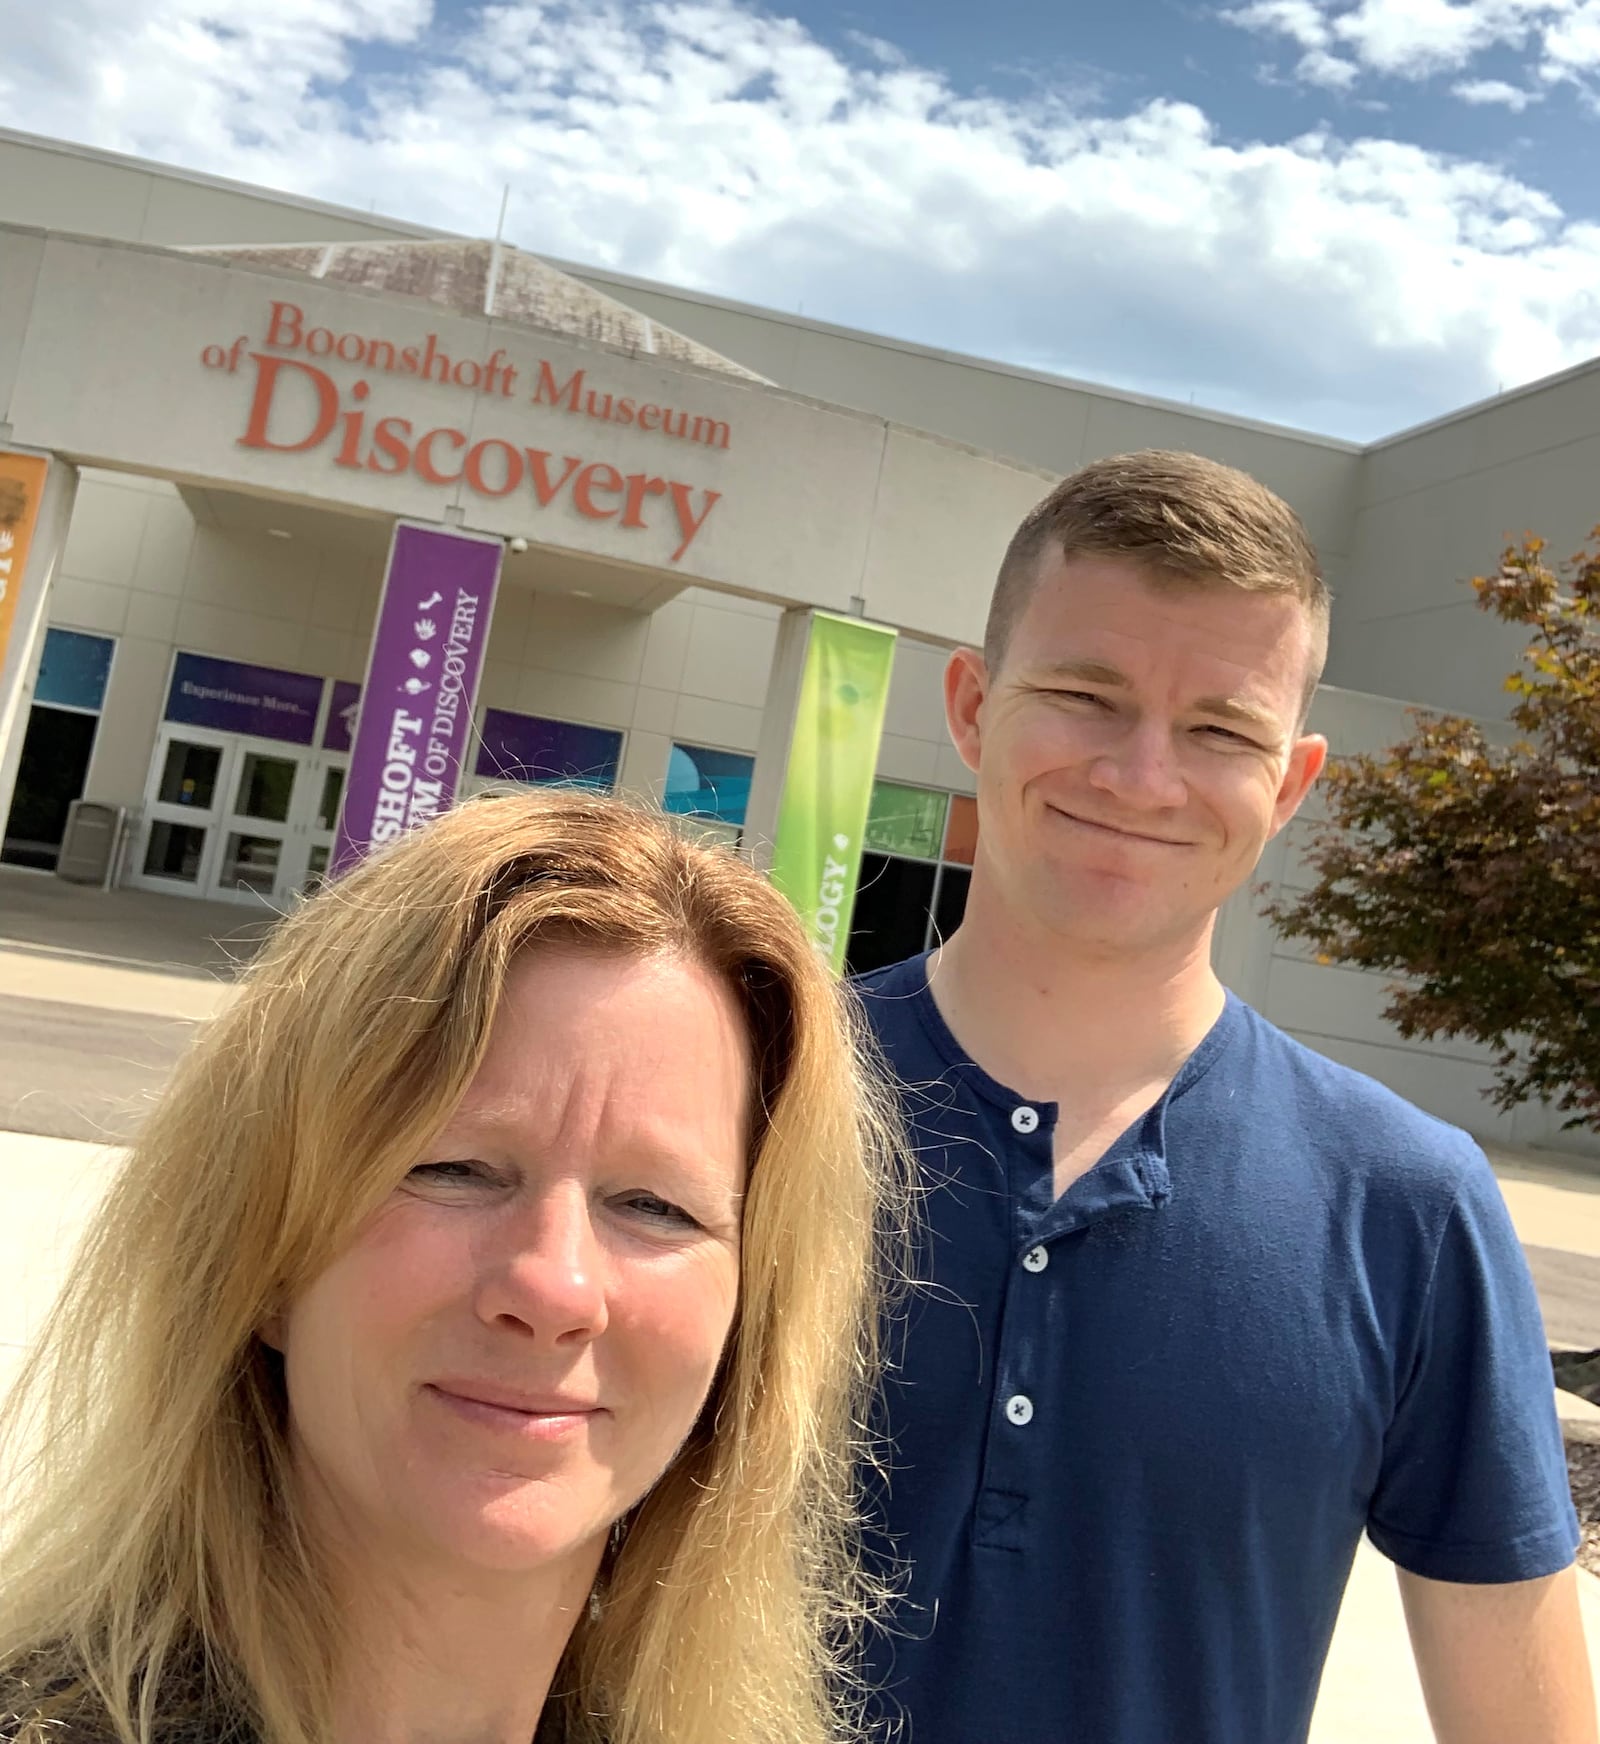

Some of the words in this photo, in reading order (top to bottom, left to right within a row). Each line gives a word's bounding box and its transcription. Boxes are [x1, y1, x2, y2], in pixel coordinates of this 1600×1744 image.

[265, 300, 517, 398] Boonshoft
[532, 359, 731, 449] Museum
[202, 336, 249, 374] of
[236, 351, 723, 563] Discovery
[180, 680, 260, 707] Experience
[432, 586, 479, 737] DISCOVERY
[369, 708, 423, 850] SHOFT
[424, 737, 449, 775] OF
